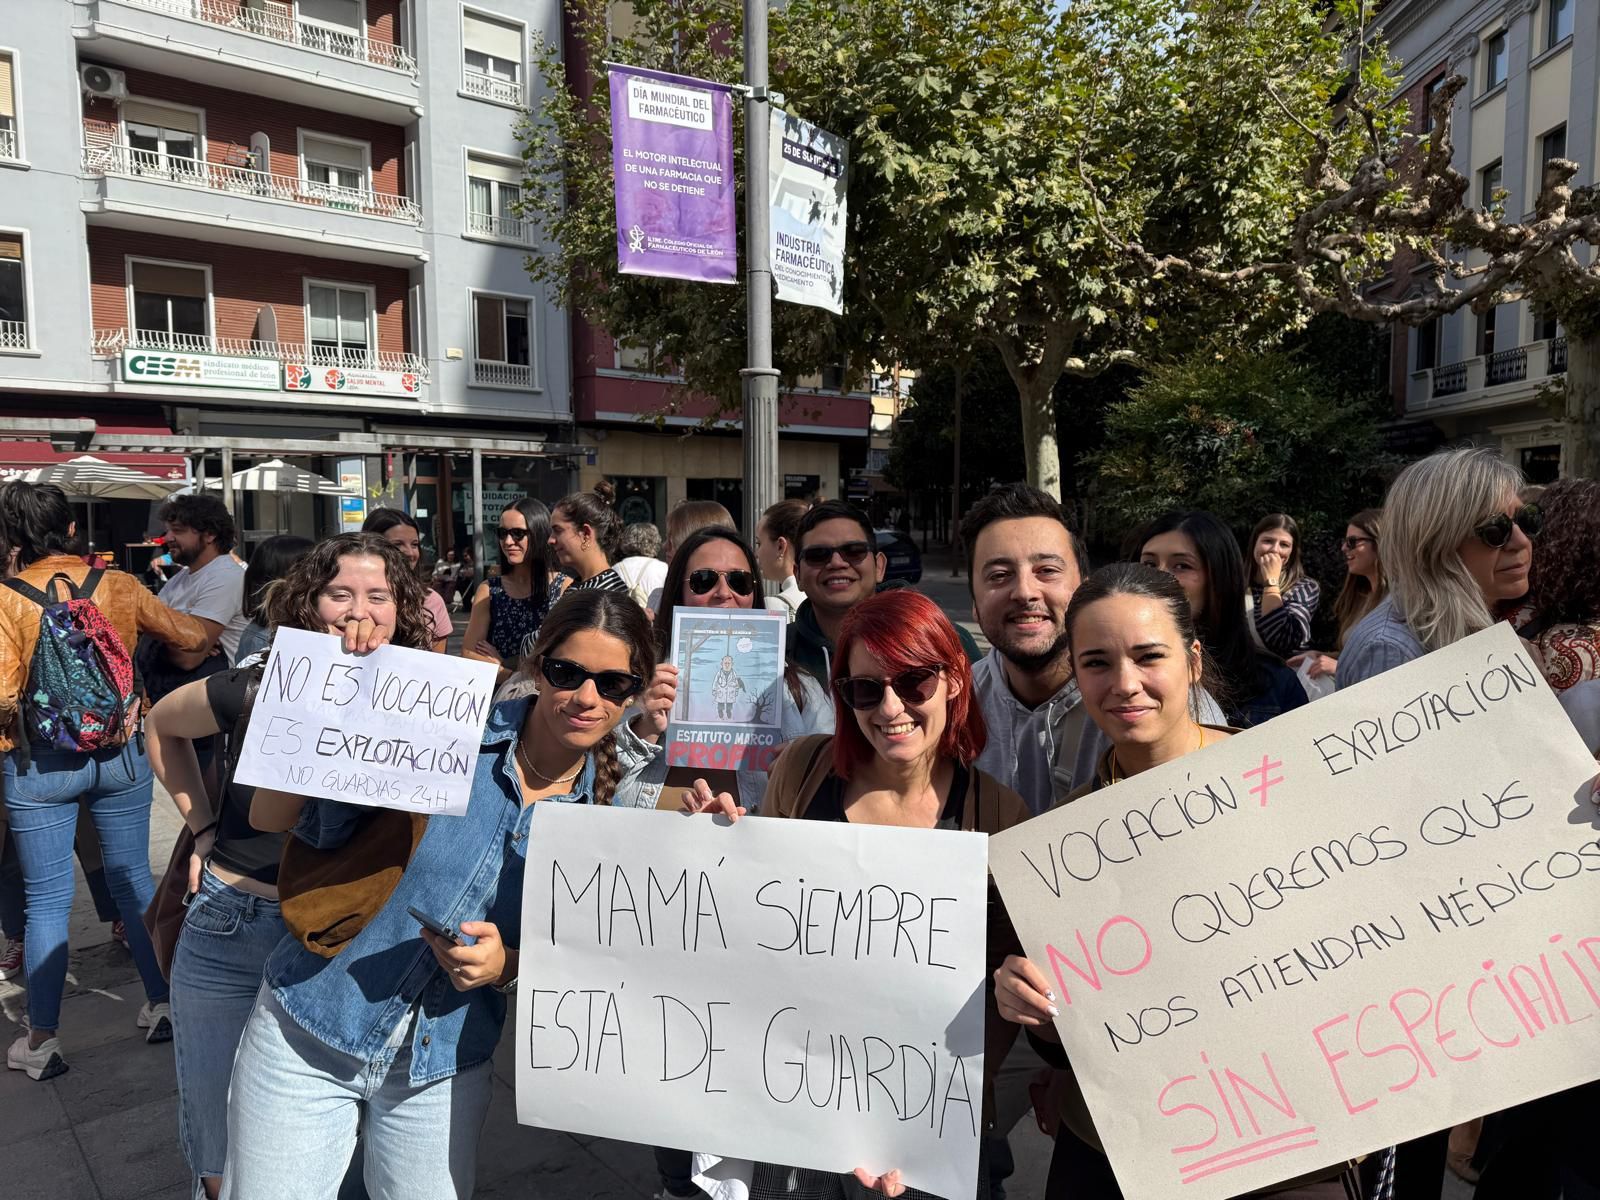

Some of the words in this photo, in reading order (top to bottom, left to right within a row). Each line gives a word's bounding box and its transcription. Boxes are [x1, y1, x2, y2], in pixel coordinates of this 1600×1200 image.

[633, 86, 648, 100] DÍA
[651, 90, 690, 108] MUNDIAL
[693, 98, 710, 111] DEL
[639, 102, 705, 123] FARMACÉUTICO
[623, 149, 634, 158] EL
[635, 150, 667, 164] MOTOR
[668, 156, 723, 171] INTELECTUAL
[783, 143, 791, 155] 25
[792, 146, 801, 158] DE
[625, 164, 638, 173] DE
[638, 165, 658, 176] UNA
[659, 169, 702, 183] FARMACIA
[704, 175, 722, 185] QUE
[644, 180, 658, 190] NO
[659, 182, 670, 191] SE
[671, 184, 705, 196] DETIENE
[776, 231, 821, 255] INDUSTRIA
[774, 273, 814, 288] MEDICAMENTO
[129, 355, 200, 378] CESM
[203, 359, 240, 369] sindicato
[203, 368, 247, 378] profesional
[249, 370, 259, 378] de
[365, 379, 385, 387] MENTAL
[263, 651, 312, 703] NO
[322, 663, 363, 706] ES
[372, 667, 486, 727] VOCACIÓN
[260, 715, 304, 755] ES
[316, 727, 468, 776] EXPLOTACIÓN
[676, 729, 732, 744] ESTATUTO
[734, 732, 774, 746] MARCO
[285, 764, 314, 786] NO
[322, 769, 401, 800] GUARDIAS
[1021, 771, 1238, 899] VOCACIÓN
[1313, 652, 1537, 776] EXPLOTACIÓN
[551, 856, 727, 952] MAMÁ
[1045, 914, 1153, 1006] NO
[1171, 826, 1408, 944] QUEREMOS
[1419, 779, 1534, 847] QUE
[1104, 994, 1199, 1052] NOS
[1220, 915, 1405, 1009] ATIENDAN
[529, 981, 626, 1074] ESTÁ
[653, 995, 731, 1093] DE
